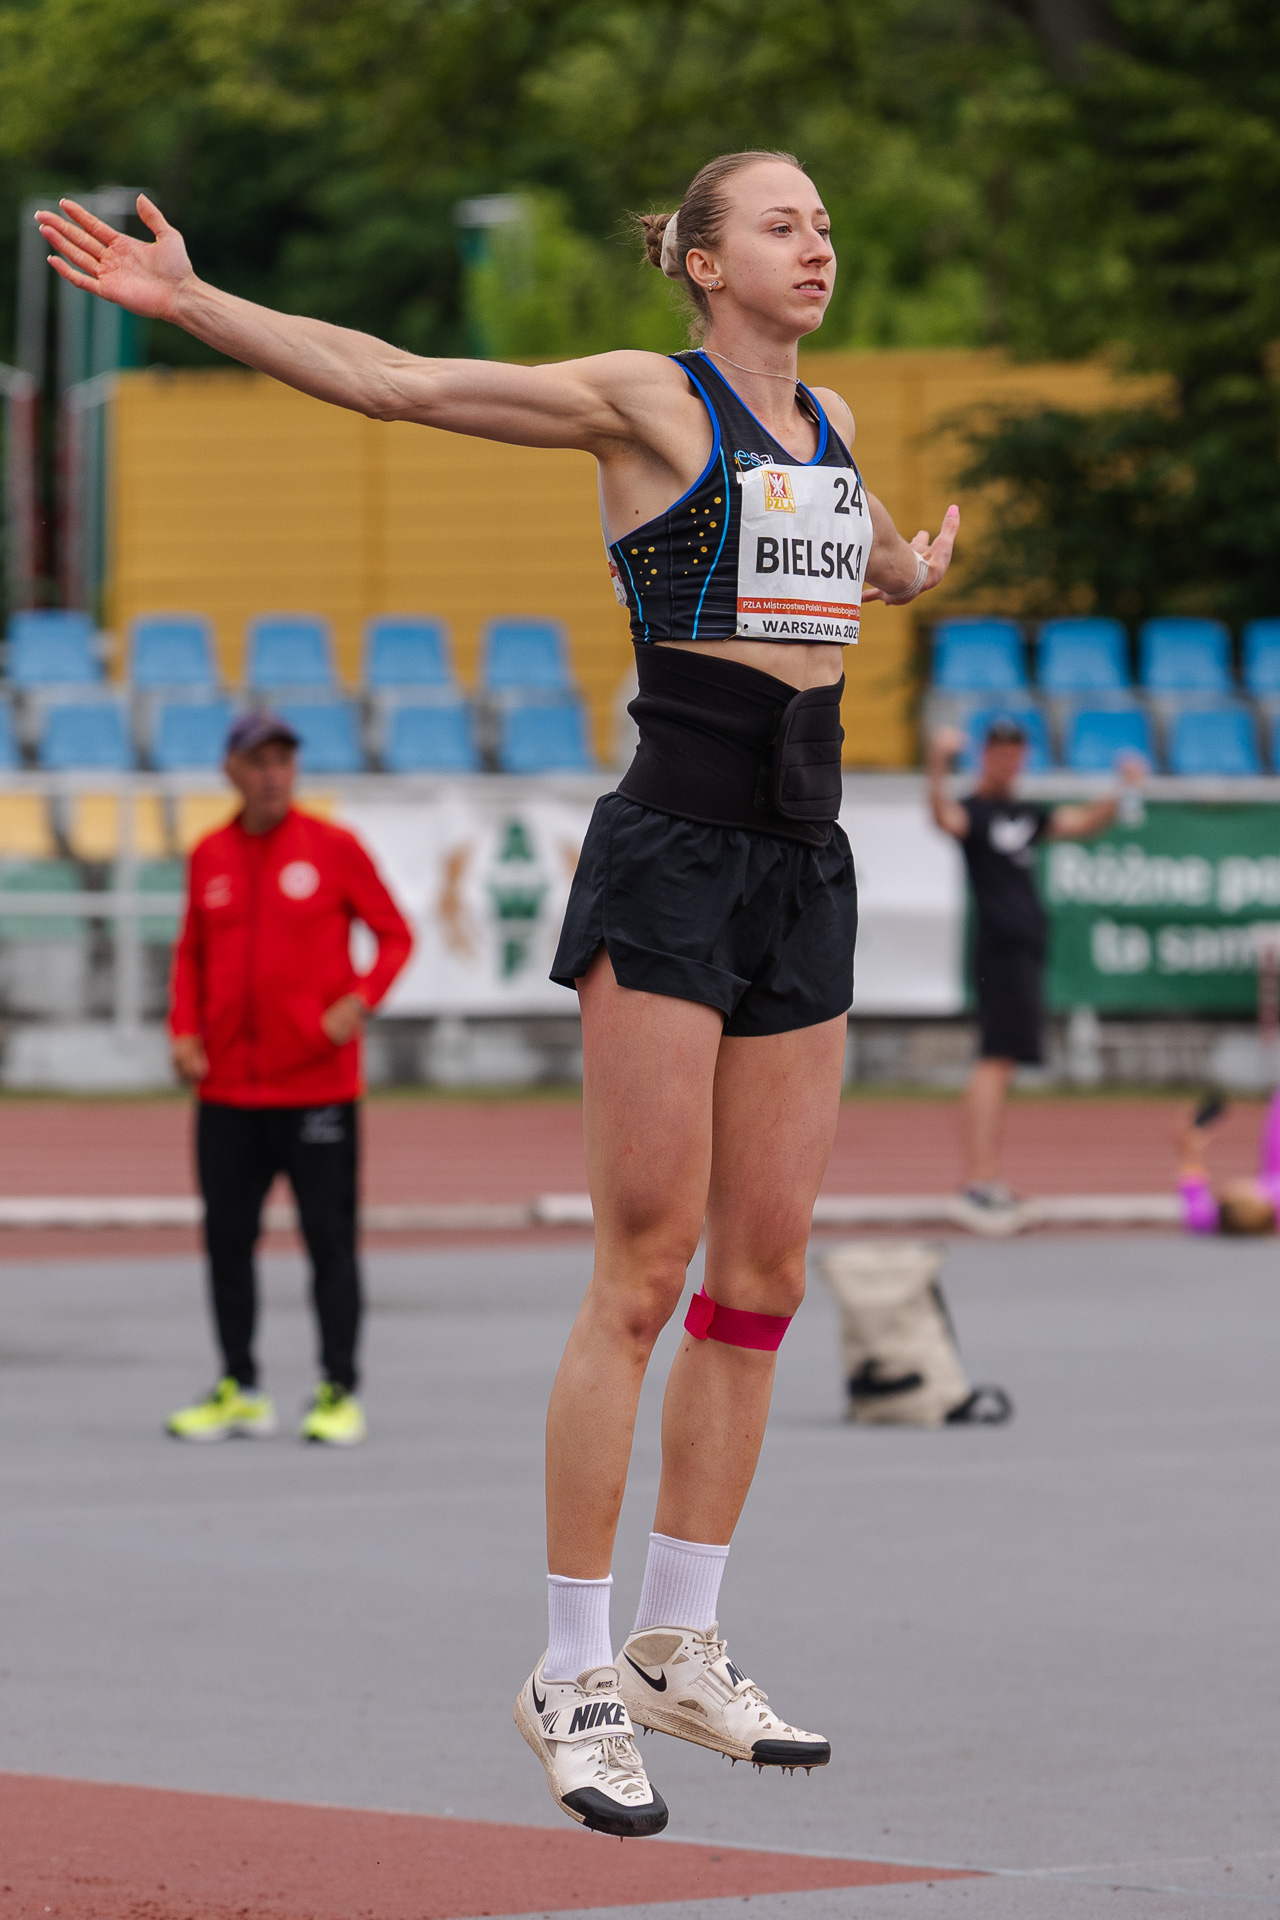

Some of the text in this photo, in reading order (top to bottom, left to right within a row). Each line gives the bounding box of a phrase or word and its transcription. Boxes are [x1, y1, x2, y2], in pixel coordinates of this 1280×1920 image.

[767, 498, 794, 511] PZLA
[833, 477, 863, 516] 24
[755, 536, 863, 583] BIELSKA
[742, 600, 762, 609] PZLA
[763, 600, 805, 612] Mistrzostwa
[805, 603, 822, 613] Polski
[762, 620, 842, 638] WARSZAWA
[568, 1702, 625, 1735] NIKE
